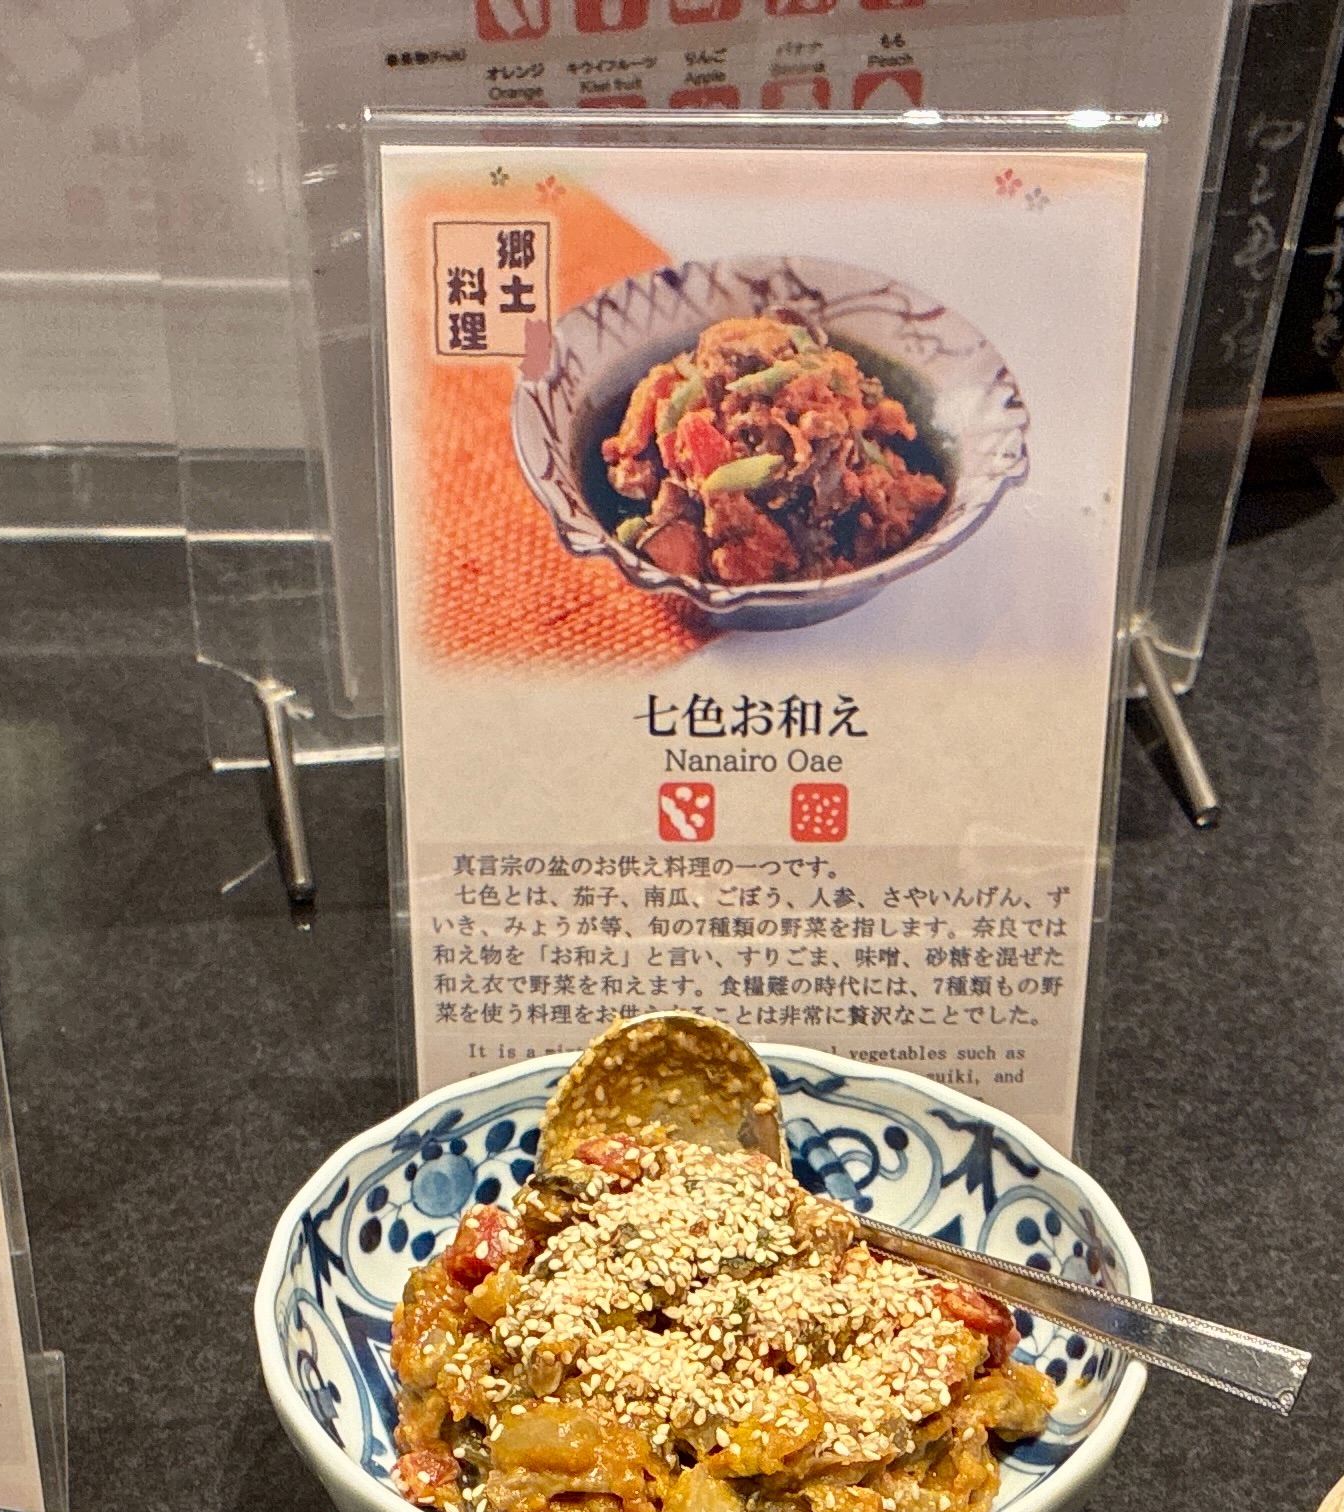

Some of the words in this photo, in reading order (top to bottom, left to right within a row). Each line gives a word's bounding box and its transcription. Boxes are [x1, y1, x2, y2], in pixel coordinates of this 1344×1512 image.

[496, 229, 536, 314] 郷土
[447, 266, 488, 350] 料理
[635, 692, 869, 741] 七色お和え
[664, 747, 777, 773] Nanairo
[787, 748, 844, 773] Oae
[453, 854, 837, 879] 真言宗の盆のお供え料理の一つです。
[469, 1043, 486, 1058] It
[499, 1043, 516, 1058] is
[526, 1047, 536, 1058] a
[849, 1045, 947, 1062] vegetables
[957, 1045, 996, 1060] such
[1005, 1049, 1025, 1060] as
[993, 1067, 1024, 1083] and
